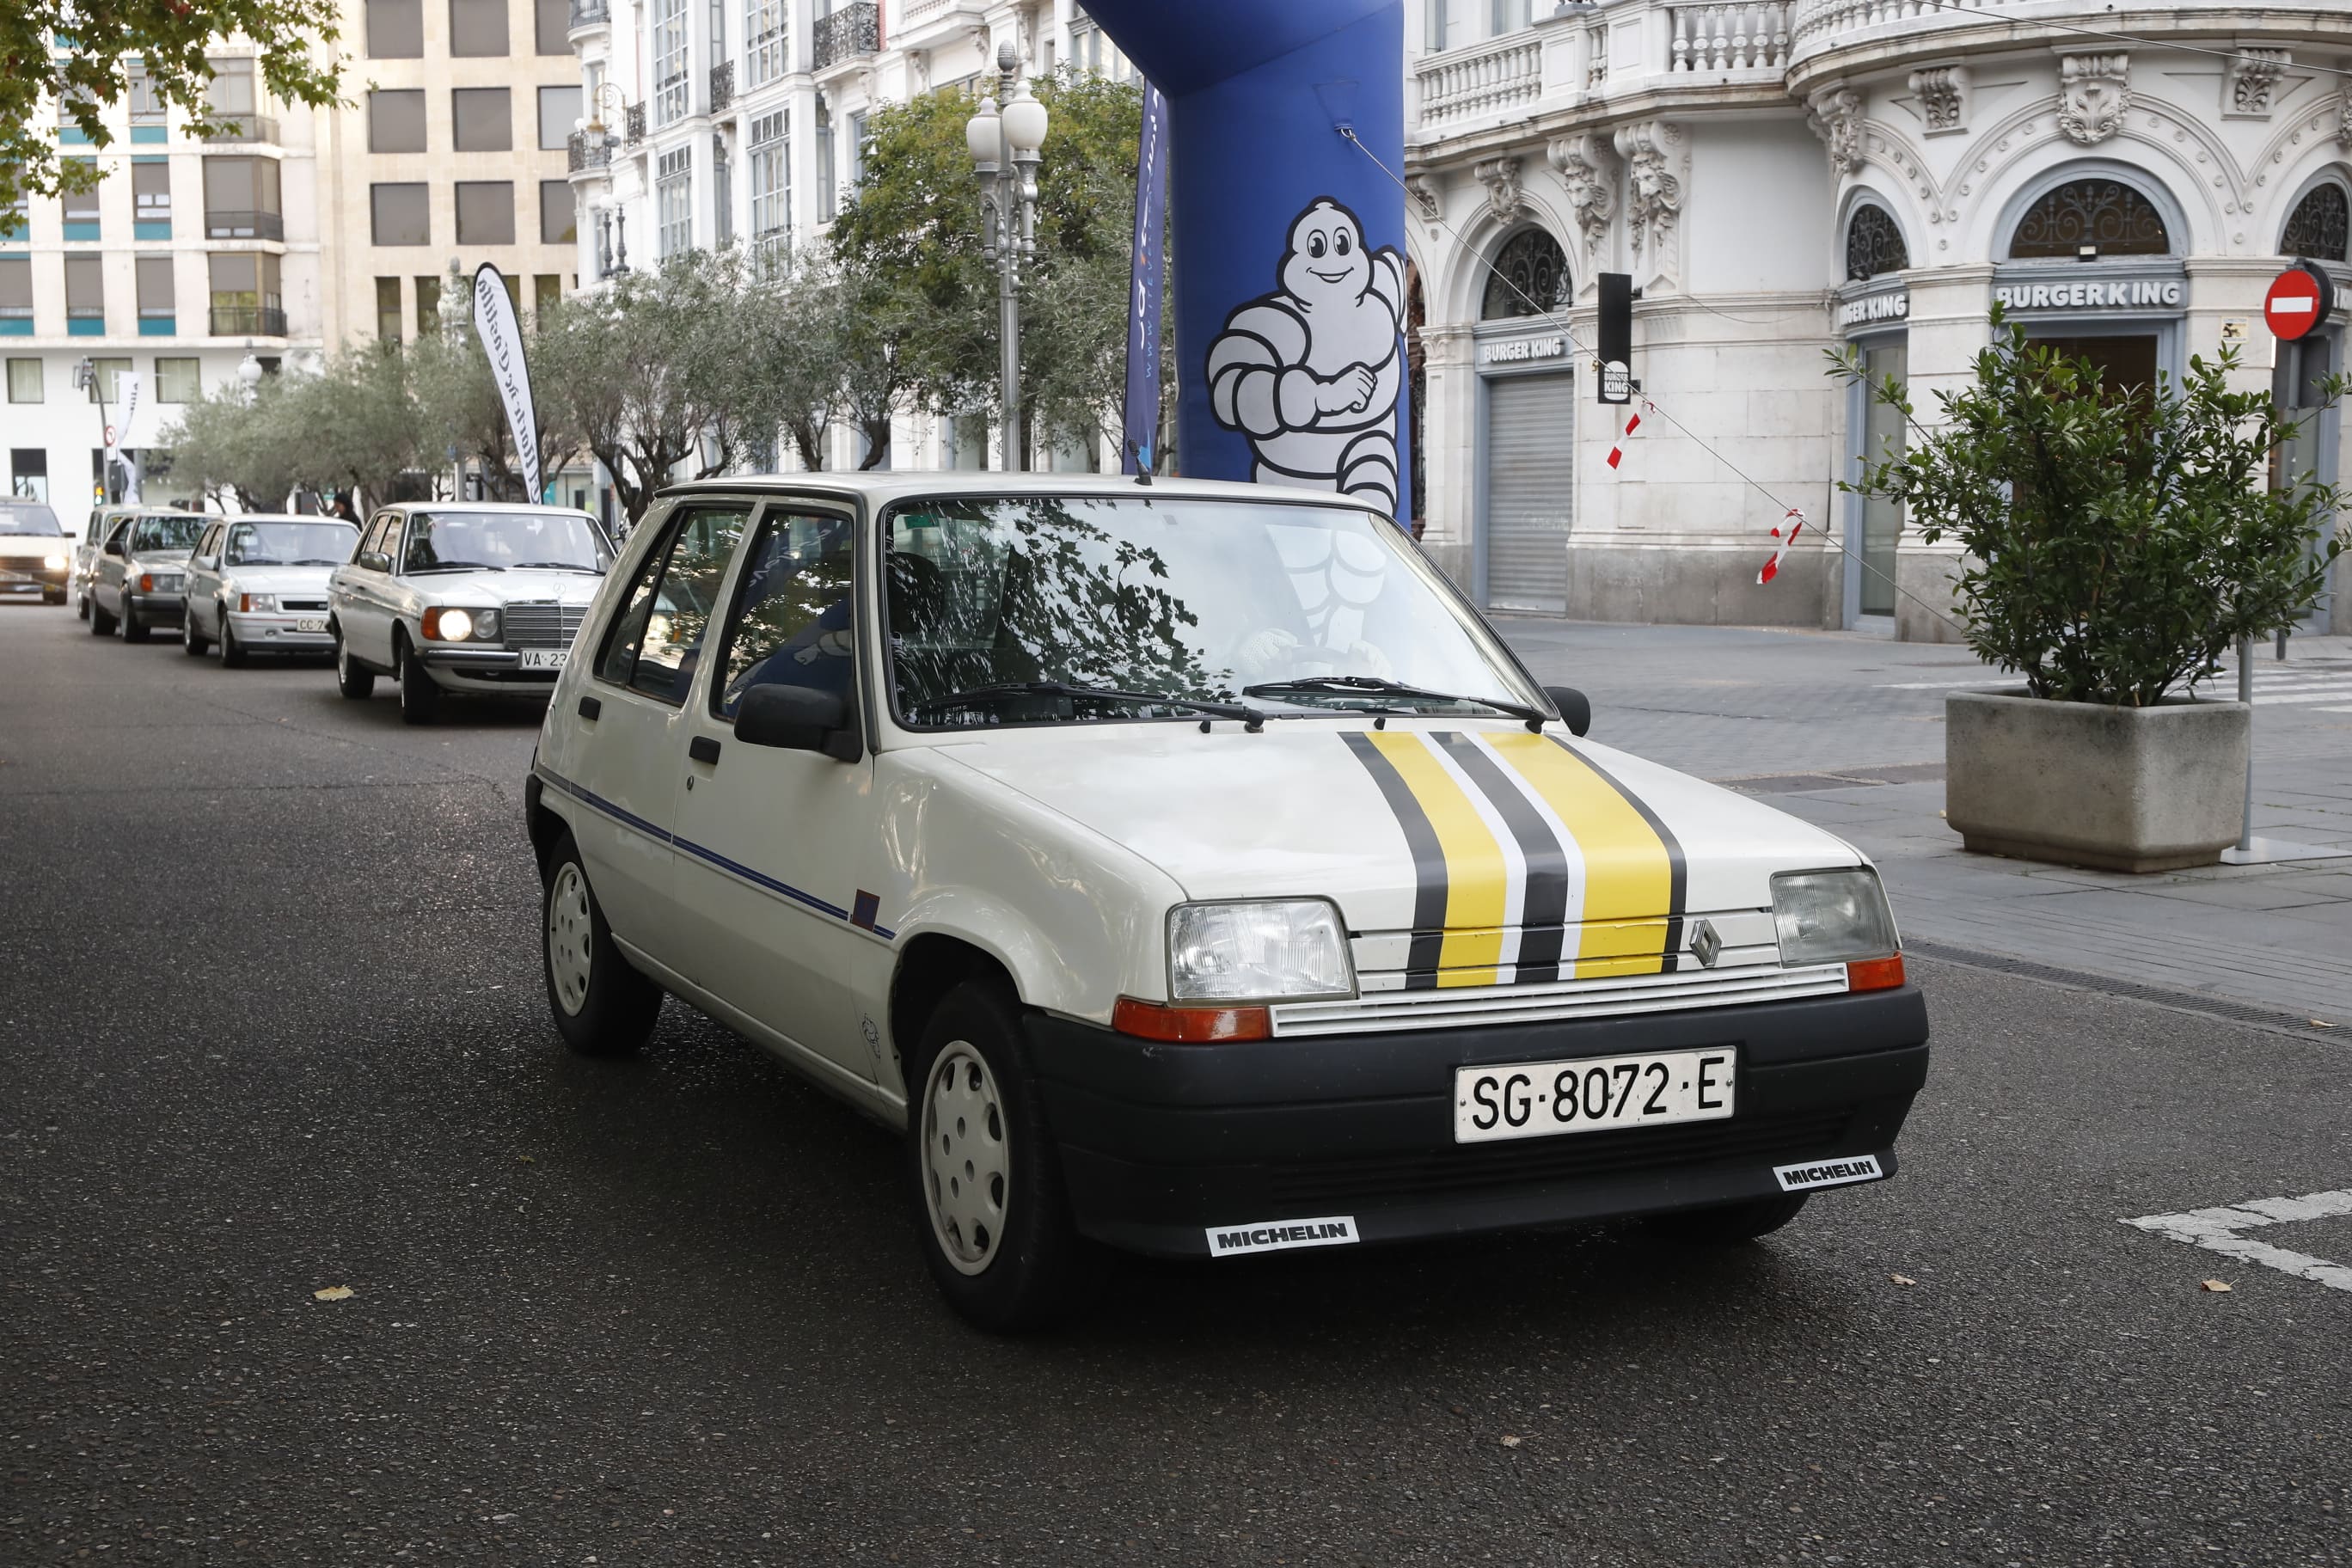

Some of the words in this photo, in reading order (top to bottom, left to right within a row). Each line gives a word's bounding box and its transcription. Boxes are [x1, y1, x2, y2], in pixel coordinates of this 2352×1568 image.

[1868, 294, 1907, 319] KING
[1996, 283, 2104, 309] BURGER
[2108, 281, 2181, 305] KING
[1485, 341, 1528, 361] BURGER
[1530, 337, 1561, 358] KING
[1604, 380, 1629, 393] KING
[1782, 1161, 1875, 1185] MICHELIN
[1216, 1222, 1348, 1249] MICHELIN
